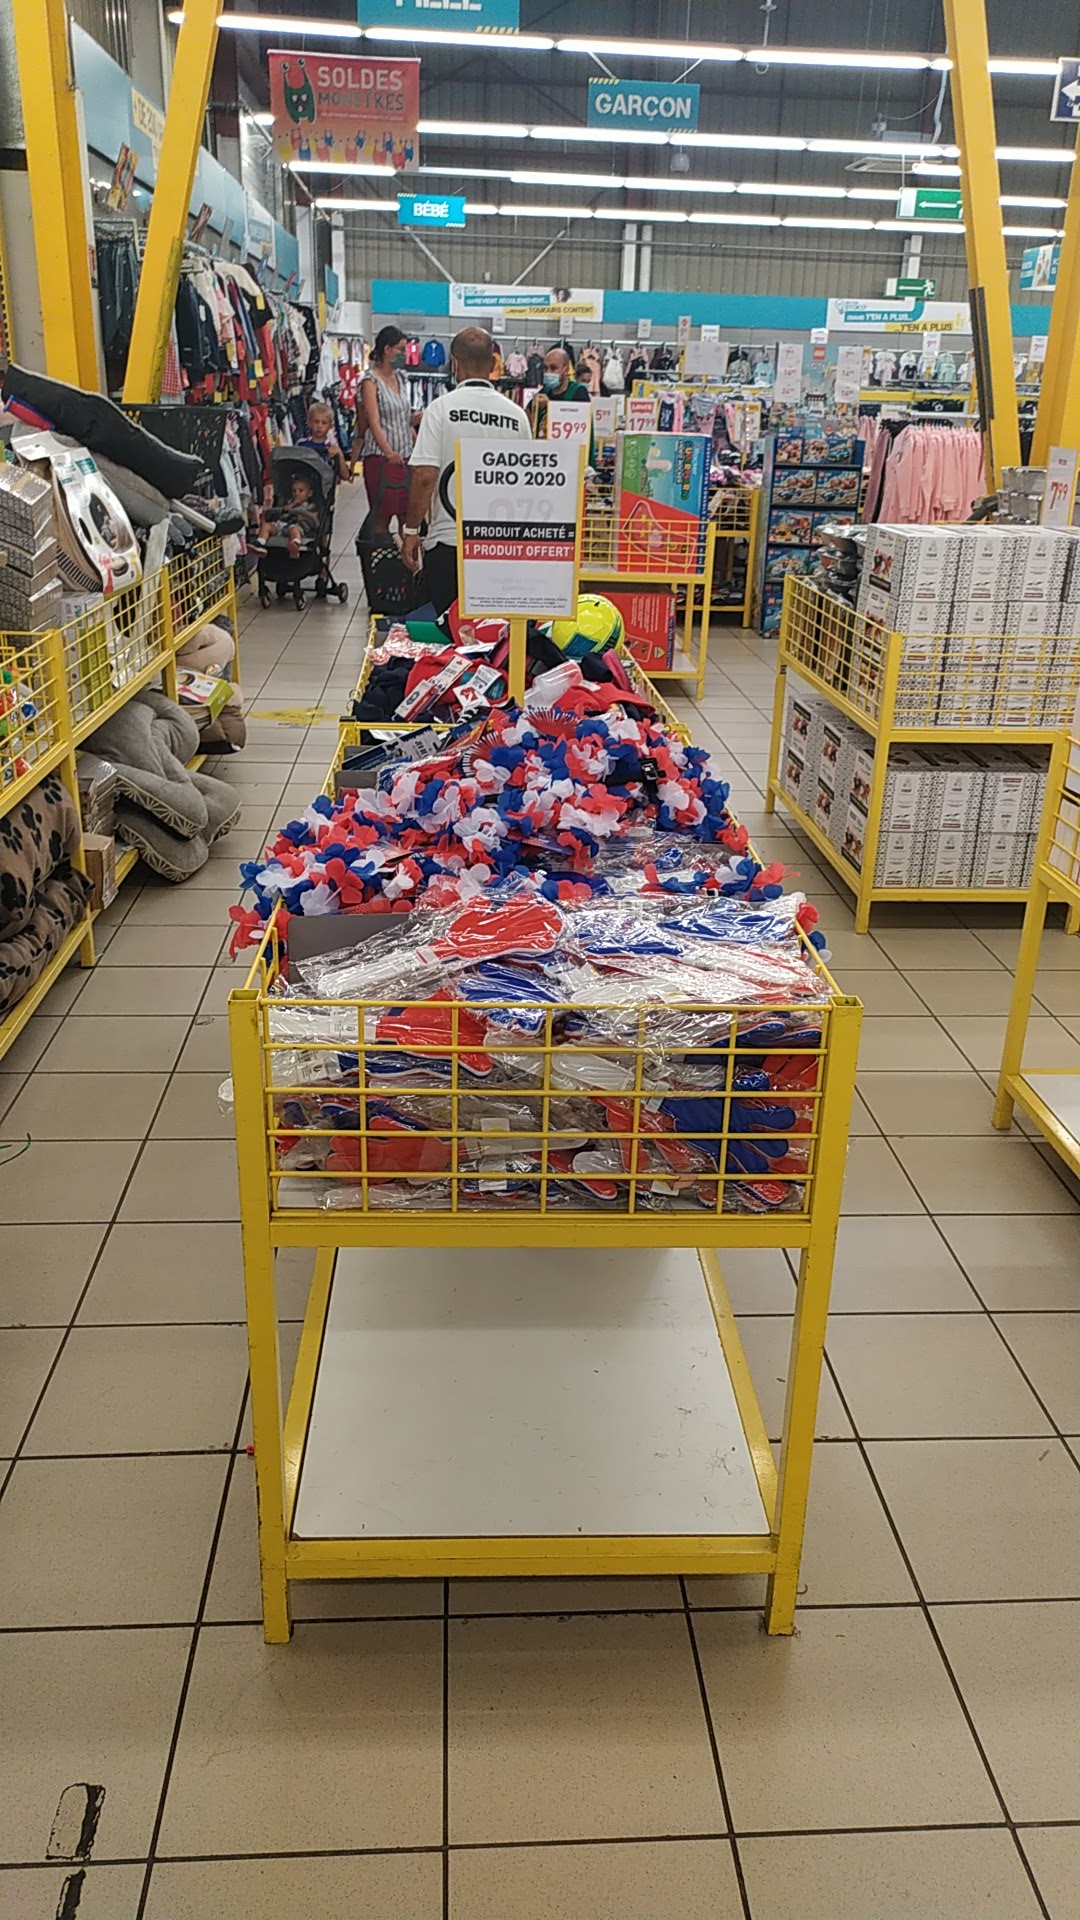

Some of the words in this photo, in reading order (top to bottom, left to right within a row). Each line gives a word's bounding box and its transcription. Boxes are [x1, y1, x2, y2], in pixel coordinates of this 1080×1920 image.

[317, 66, 403, 91] SOLDES
[318, 91, 404, 111] MONSTRES
[595, 93, 692, 121] GARÇON
[413, 200, 449, 218] BÉBÉ
[563, 306, 594, 314] CONTENT
[921, 324, 928, 332] A
[930, 324, 953, 332] PLUS
[449, 410, 519, 432] SECURITE
[551, 421, 587, 439] 5999
[482, 452, 558, 468] GADGETS
[474, 471, 519, 485] EURO
[524, 472, 566, 487] 2020
[464, 526, 470, 536] 1
[473, 526, 522, 538] PRODUIT
[523, 526, 566, 538] ACHETÉ
[464, 544, 470, 555] 1
[473, 544, 523, 556] PRODUIT
